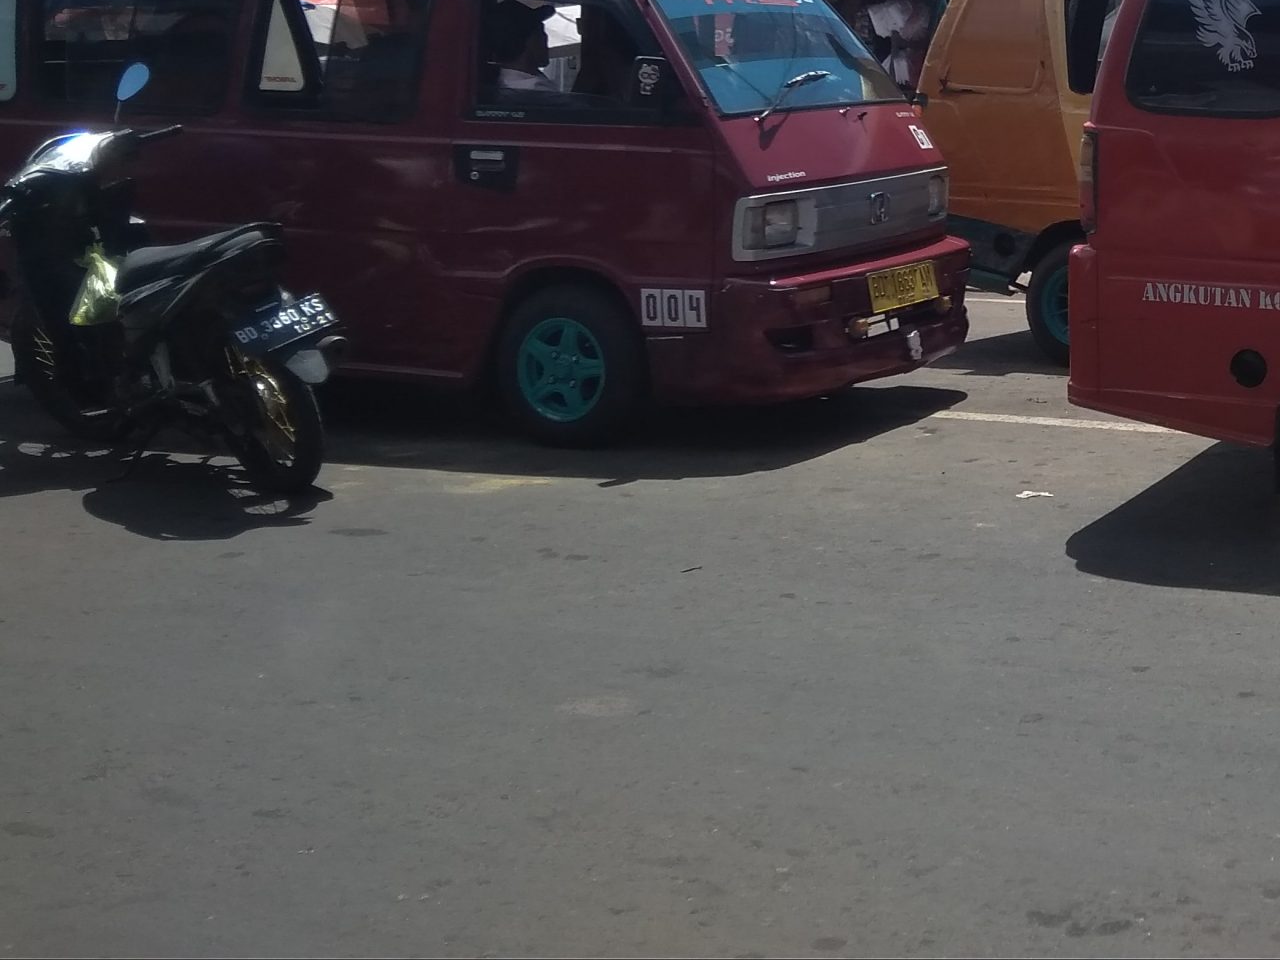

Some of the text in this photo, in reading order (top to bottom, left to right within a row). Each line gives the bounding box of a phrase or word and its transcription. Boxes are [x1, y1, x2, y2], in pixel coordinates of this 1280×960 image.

[645, 293, 702, 323] 004
[1142, 282, 1251, 309] ANGKUTAN
[234, 298, 325, 344] BD 3360 KS
